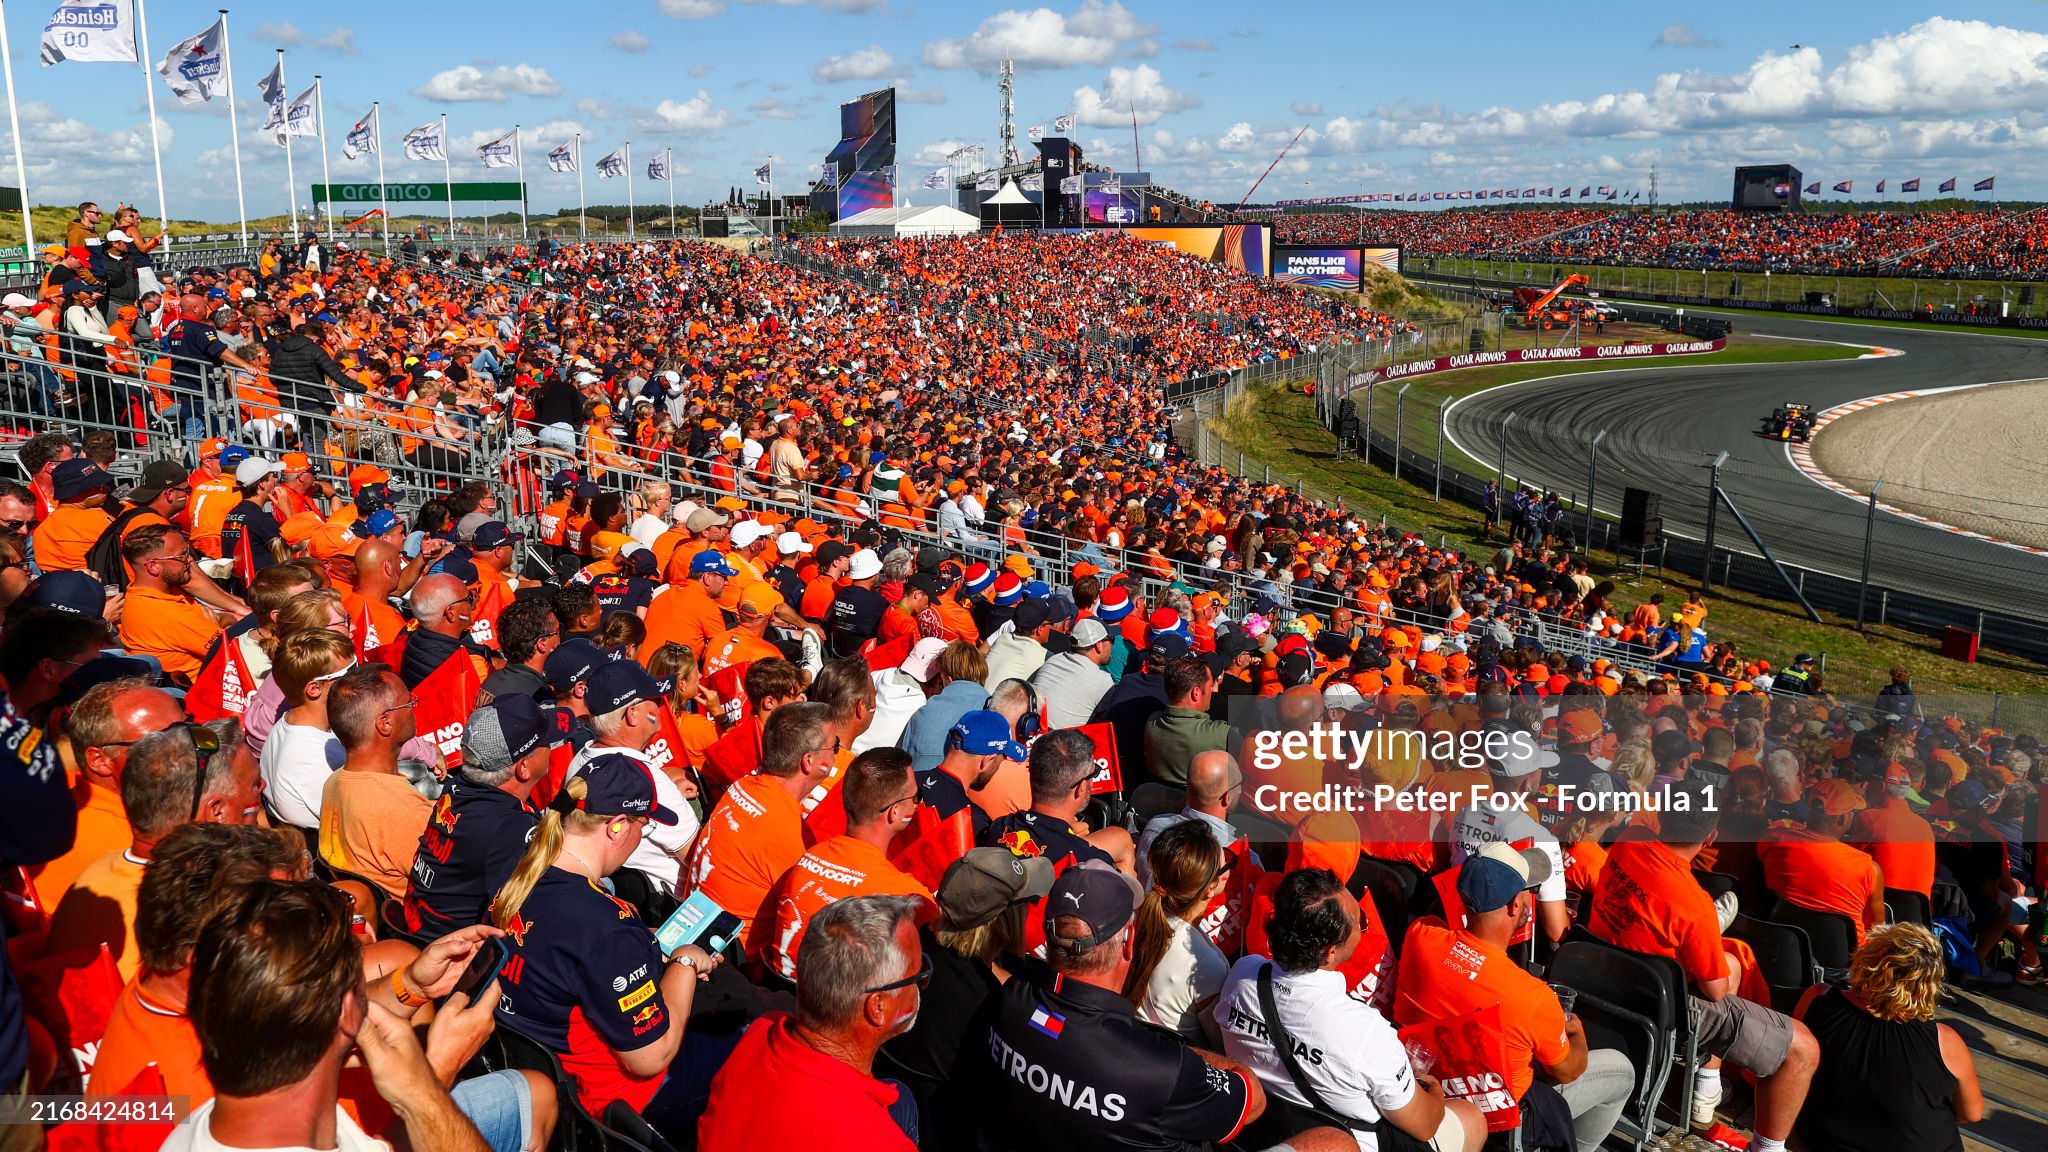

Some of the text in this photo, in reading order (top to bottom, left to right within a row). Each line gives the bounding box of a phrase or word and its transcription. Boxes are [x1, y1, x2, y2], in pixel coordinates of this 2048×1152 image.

[342, 185, 431, 200] aramco
[0, 246, 24, 259] amco
[1288, 257, 1346, 266] FANS LIKE
[1287, 266, 1346, 275] NO OTHER
[1854, 308, 1914, 319] QATAR AIRWAYS
[1931, 313, 1999, 324] QATAR AIRWAYS
[1521, 347, 1581, 360] QATAR AIRWAYS
[1597, 344, 1652, 357] QATAR AIRWAYS
[1666, 341, 1713, 353] QATAR AIRWAYS
[1450, 351, 1506, 367] QATAR AIRWAYS
[1386, 359, 1436, 379] QATAR AIRWAYS
[194, 494, 207, 528] 1
[593, 585, 629, 594] Red Bull
[204, 630, 221, 650] CREW
[620, 689, 637, 701] viaplay
[436, 722, 464, 742] NO
[519, 734, 539, 753] exact
[622, 799, 650, 808] CarNext
[727, 784, 763, 818] ZANDVOORT
[1453, 822, 1509, 844] PETRONA
[798, 857, 863, 887] ZANDVOORT
[1455, 941, 1487, 961] ORACLE
[500, 954, 525, 985] ull
[629, 964, 648, 984] AT&T
[1274, 981, 1292, 993] BOSS
[622, 984, 653, 1008] PIRELLI
[632, 1019, 652, 1036] Red
[1227, 1006, 1324, 1066] PETRNAS
[1441, 1072, 1504, 1097] KE NO
